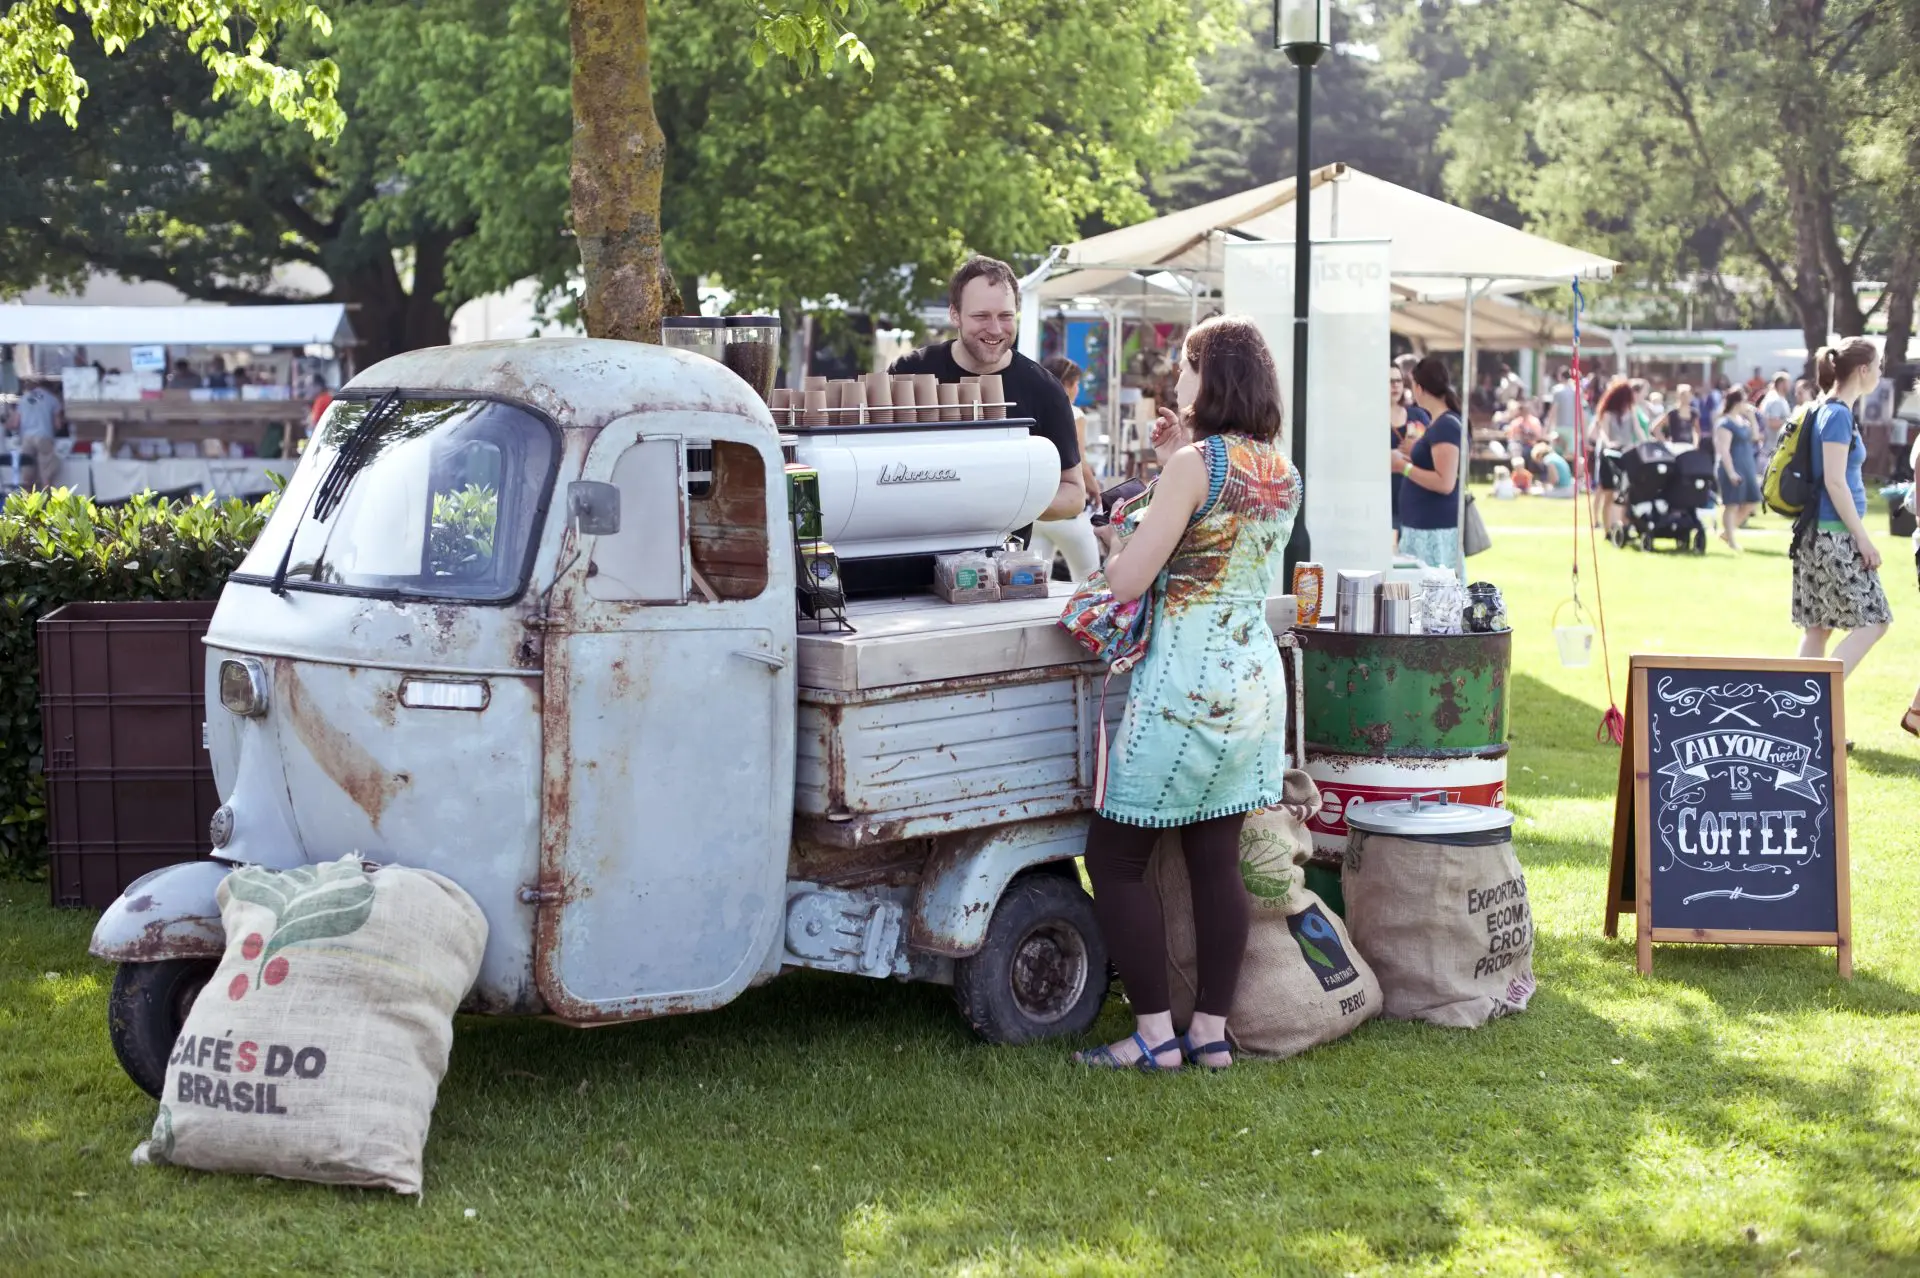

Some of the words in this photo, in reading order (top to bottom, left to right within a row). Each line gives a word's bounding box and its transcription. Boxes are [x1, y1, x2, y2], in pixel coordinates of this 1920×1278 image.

[1685, 735, 1723, 766] ALL
[1722, 733, 1775, 763] YOU
[1769, 745, 1804, 763] need
[1729, 766, 1752, 791] IS
[1678, 807, 1808, 855] COFFEE
[1339, 989, 1366, 1016] PERU
[170, 1029, 259, 1073] CAFÉS
[264, 1044, 327, 1080] DO
[178, 1071, 287, 1115] BRASIL
